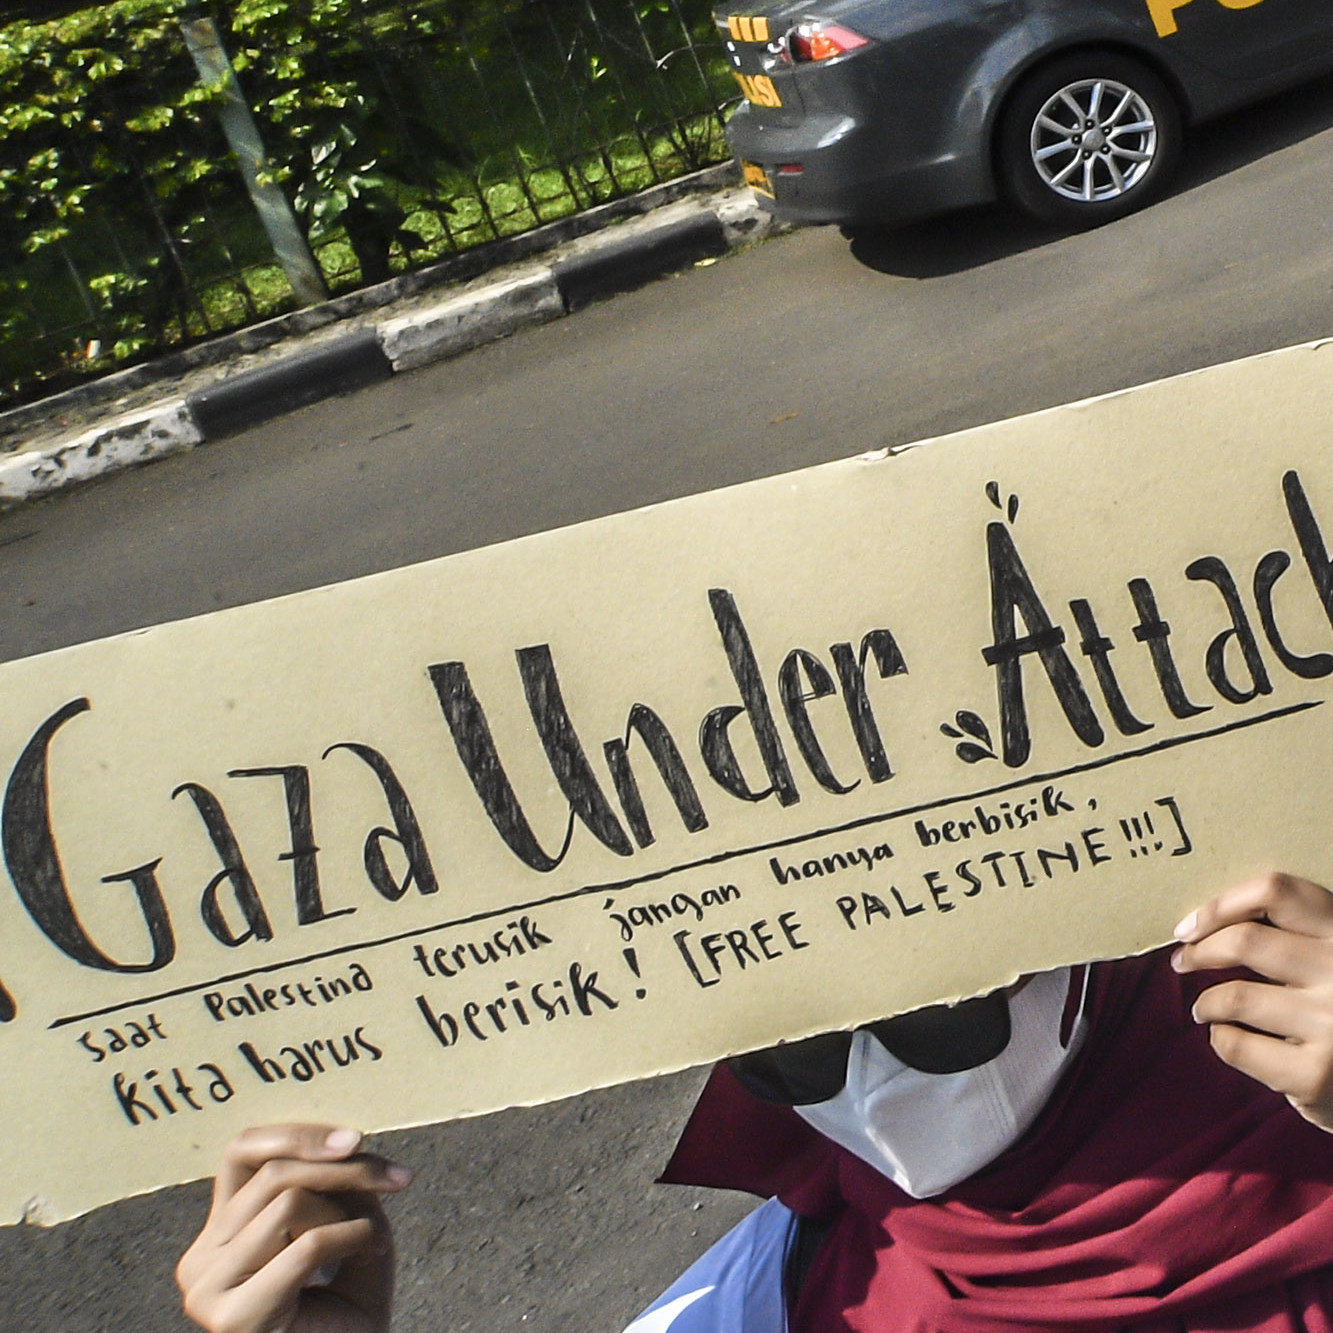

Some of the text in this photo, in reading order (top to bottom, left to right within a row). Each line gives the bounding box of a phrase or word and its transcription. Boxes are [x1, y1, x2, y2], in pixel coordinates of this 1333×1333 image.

[1, 695, 439, 974] Gaza
[427, 588, 909, 873] Under
[203, 962, 374, 1023] Palestina
[414, 915, 554, 978] terusik
[601, 879, 742, 942] jangan
[769, 840, 894, 887] hanya
[914, 784, 1099, 849] berbisik,
[238, 1024, 383, 1084] harus
[416, 948, 650, 1050] berisik!
[677, 906, 803, 989] [FREE
